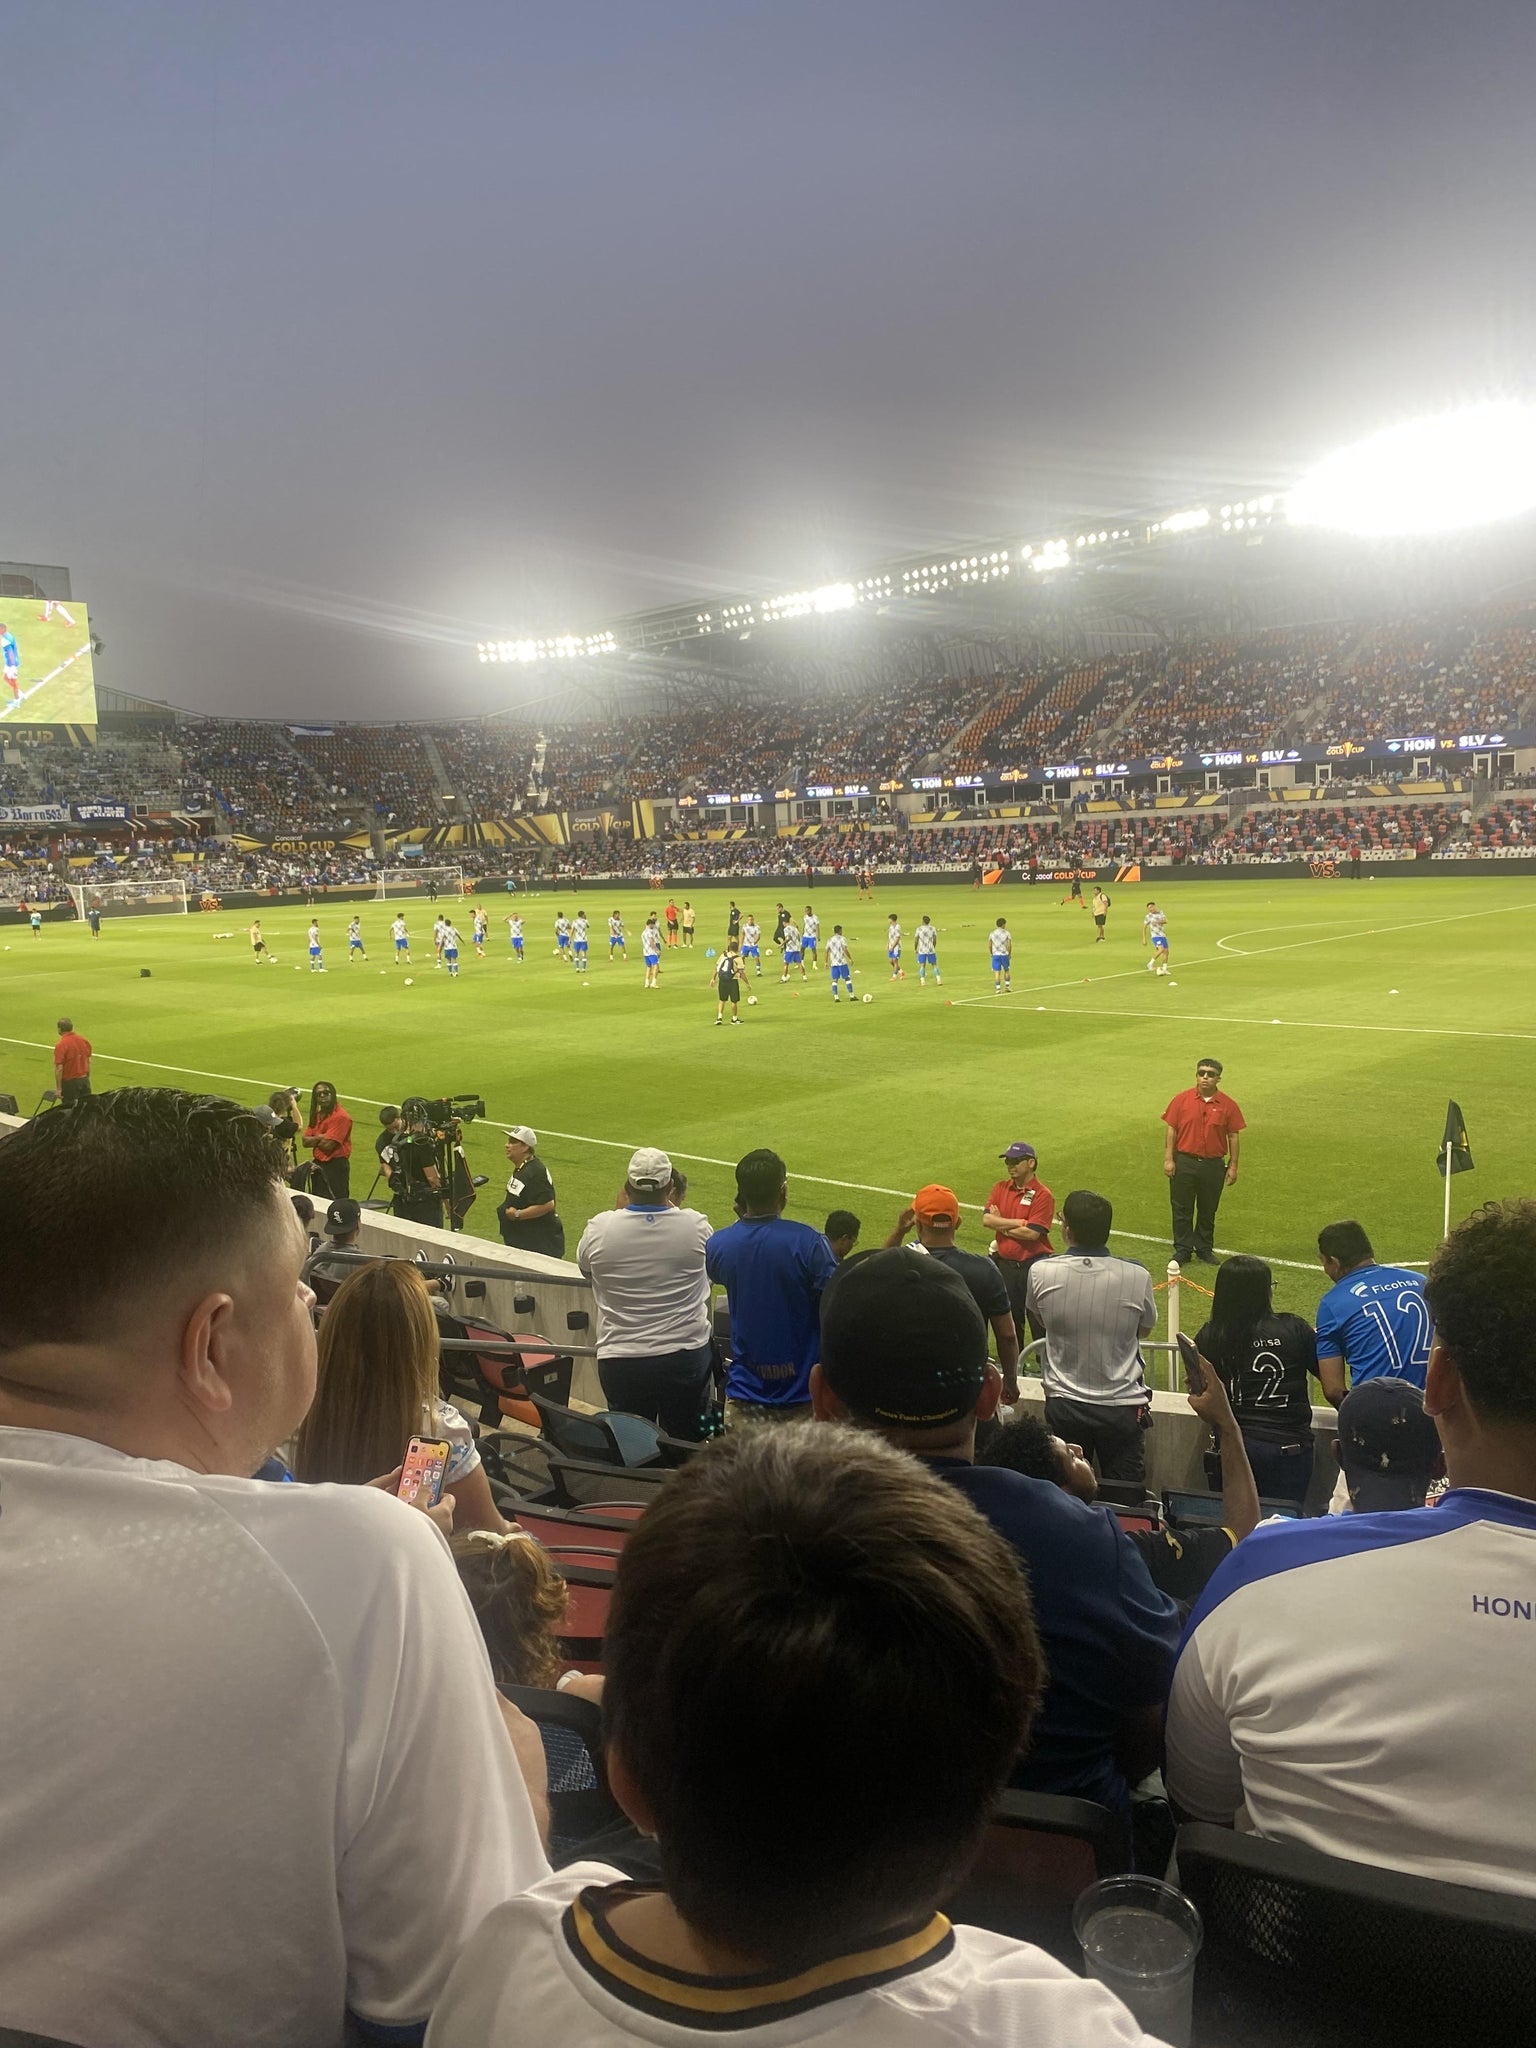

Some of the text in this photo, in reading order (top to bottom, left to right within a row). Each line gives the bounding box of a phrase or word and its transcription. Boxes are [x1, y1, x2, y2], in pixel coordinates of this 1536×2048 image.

[1403, 738, 1436, 752] HON
[1459, 734, 1487, 747] SLV
[1215, 753, 1242, 766] HON
[1261, 750, 1285, 761] SLV
[1056, 766, 1080, 778] HON
[1095, 763, 1115, 774] SLV
[922, 779, 942, 789] HON
[572, 820, 631, 832] GOLD CUP
[271, 840, 336, 853] GOLD CUP
[1053, 872, 1074, 880] GOLD
[1081, 871, 1096, 879] CUP
[1371, 1279, 1419, 1294] Ficohsa
[1362, 1290, 1431, 1369] 12
[1252, 1338, 1282, 1348] ohsa
[1472, 1594, 1536, 1620] HON
